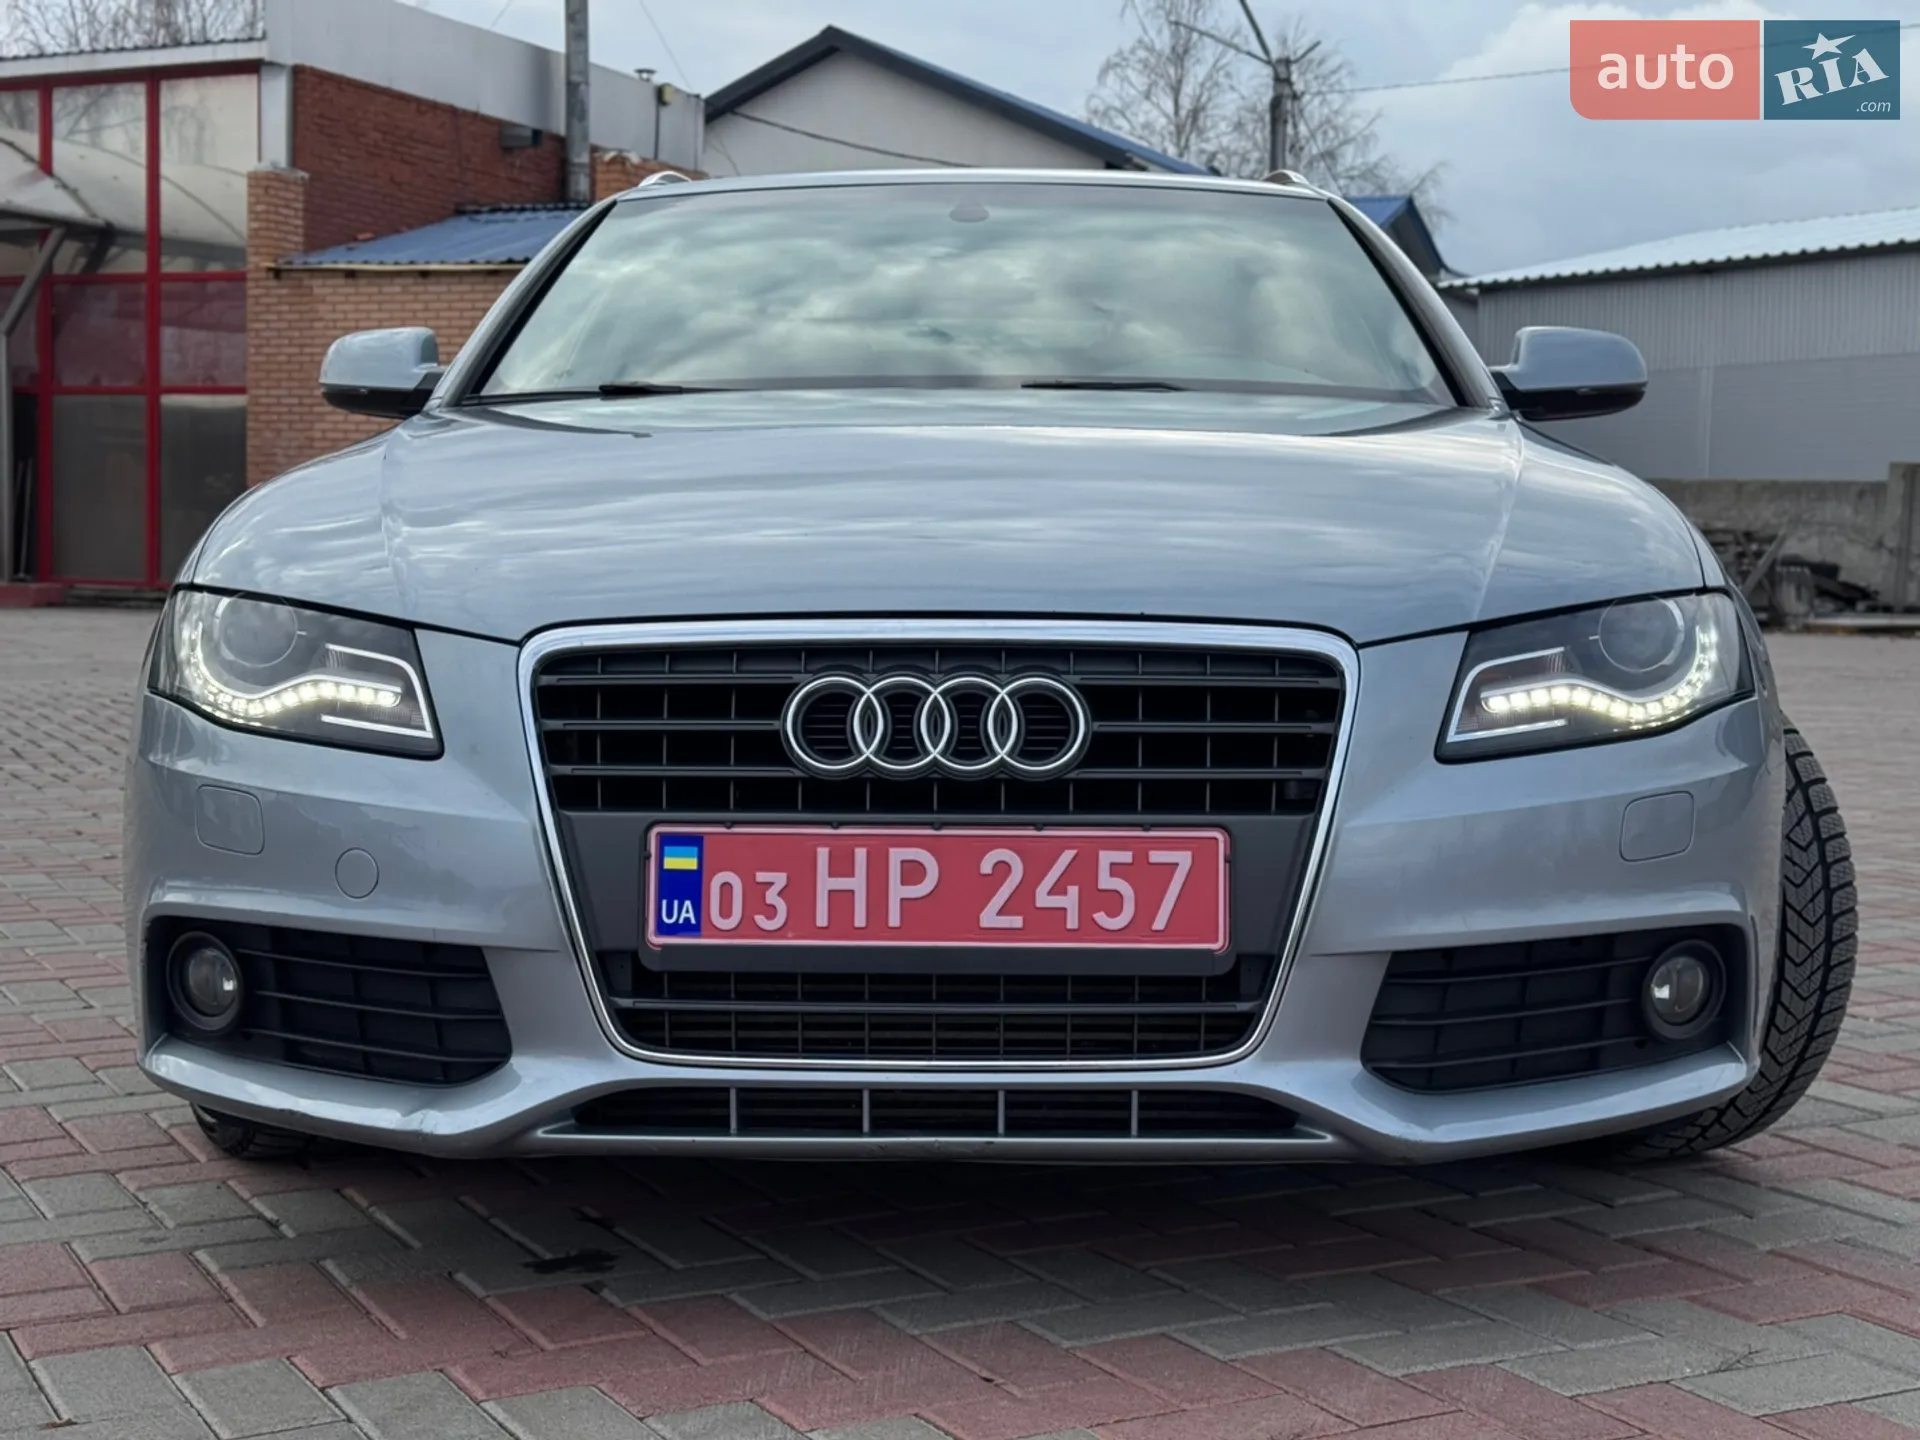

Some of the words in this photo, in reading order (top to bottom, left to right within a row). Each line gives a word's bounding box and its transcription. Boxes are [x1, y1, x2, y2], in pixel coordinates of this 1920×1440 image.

[661, 899, 697, 925] UA
[709, 870, 788, 932] 03
[815, 846, 940, 929] HP
[978, 848, 1193, 932] 2457
